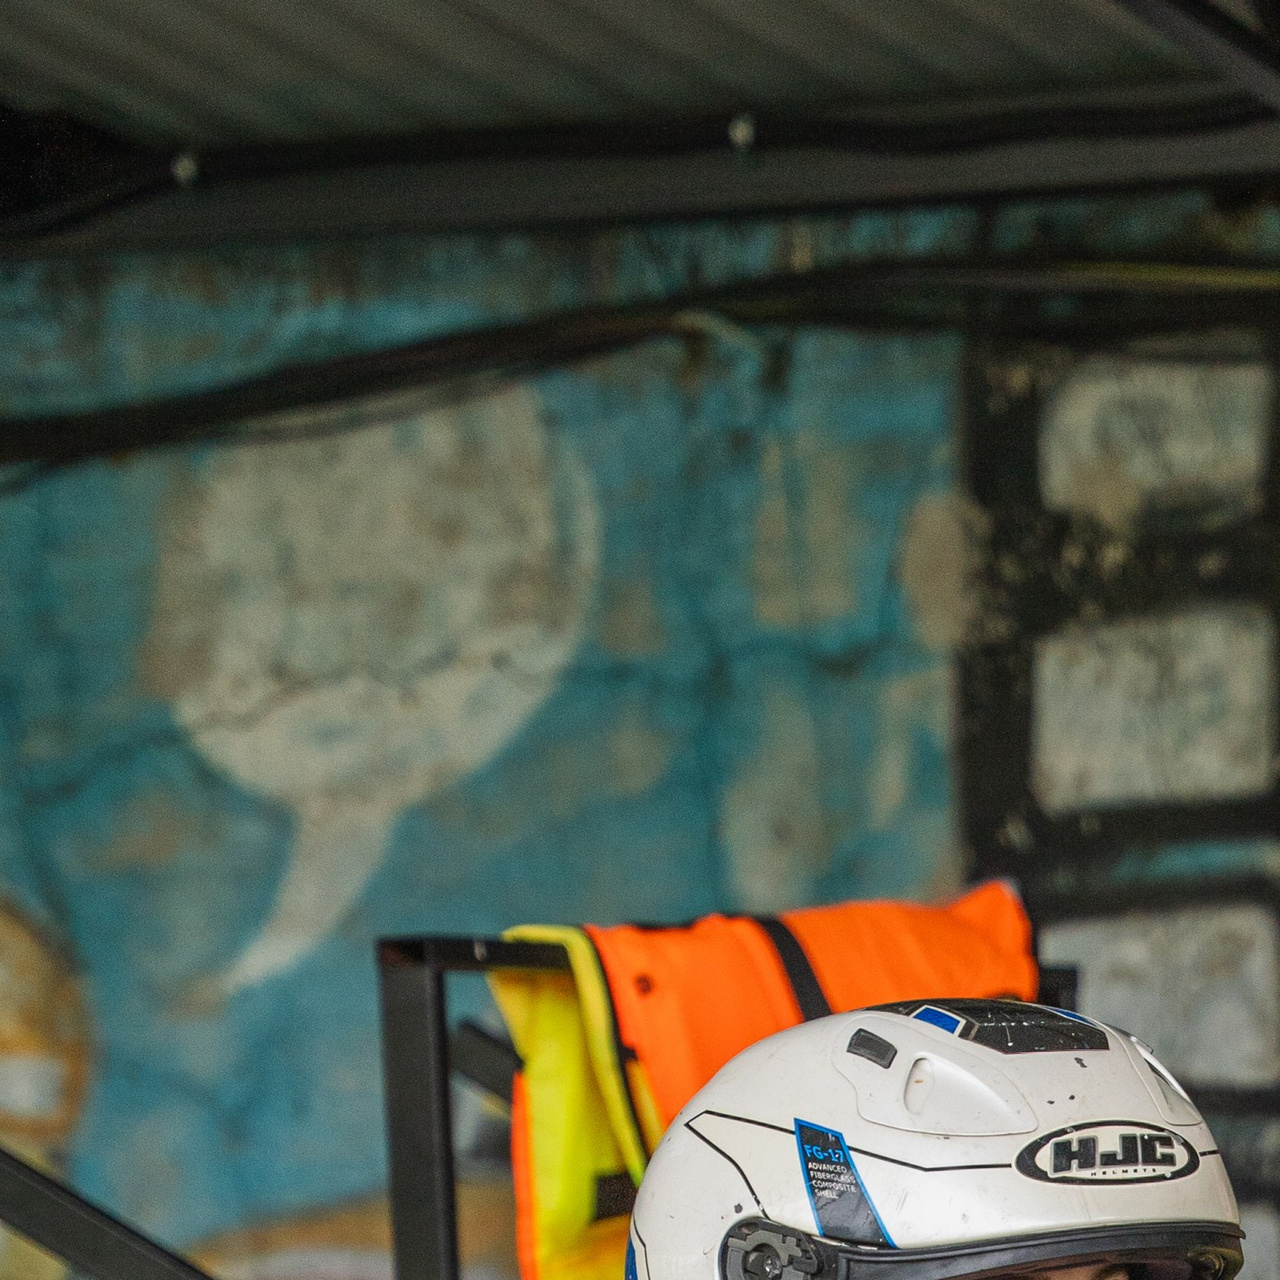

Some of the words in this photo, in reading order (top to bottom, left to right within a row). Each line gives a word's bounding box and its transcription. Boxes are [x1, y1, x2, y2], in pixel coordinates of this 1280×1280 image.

[804, 1144, 845, 1163] FG-17
[1052, 1134, 1177, 1173] HJC
[808, 1162, 847, 1174] ADVANCED
[1091, 1168, 1157, 1176] HELMETS
[810, 1170, 857, 1184] FIBERGLASS
[811, 1180, 857, 1193] COMPOSITE
[814, 1188, 839, 1199] SHELL
